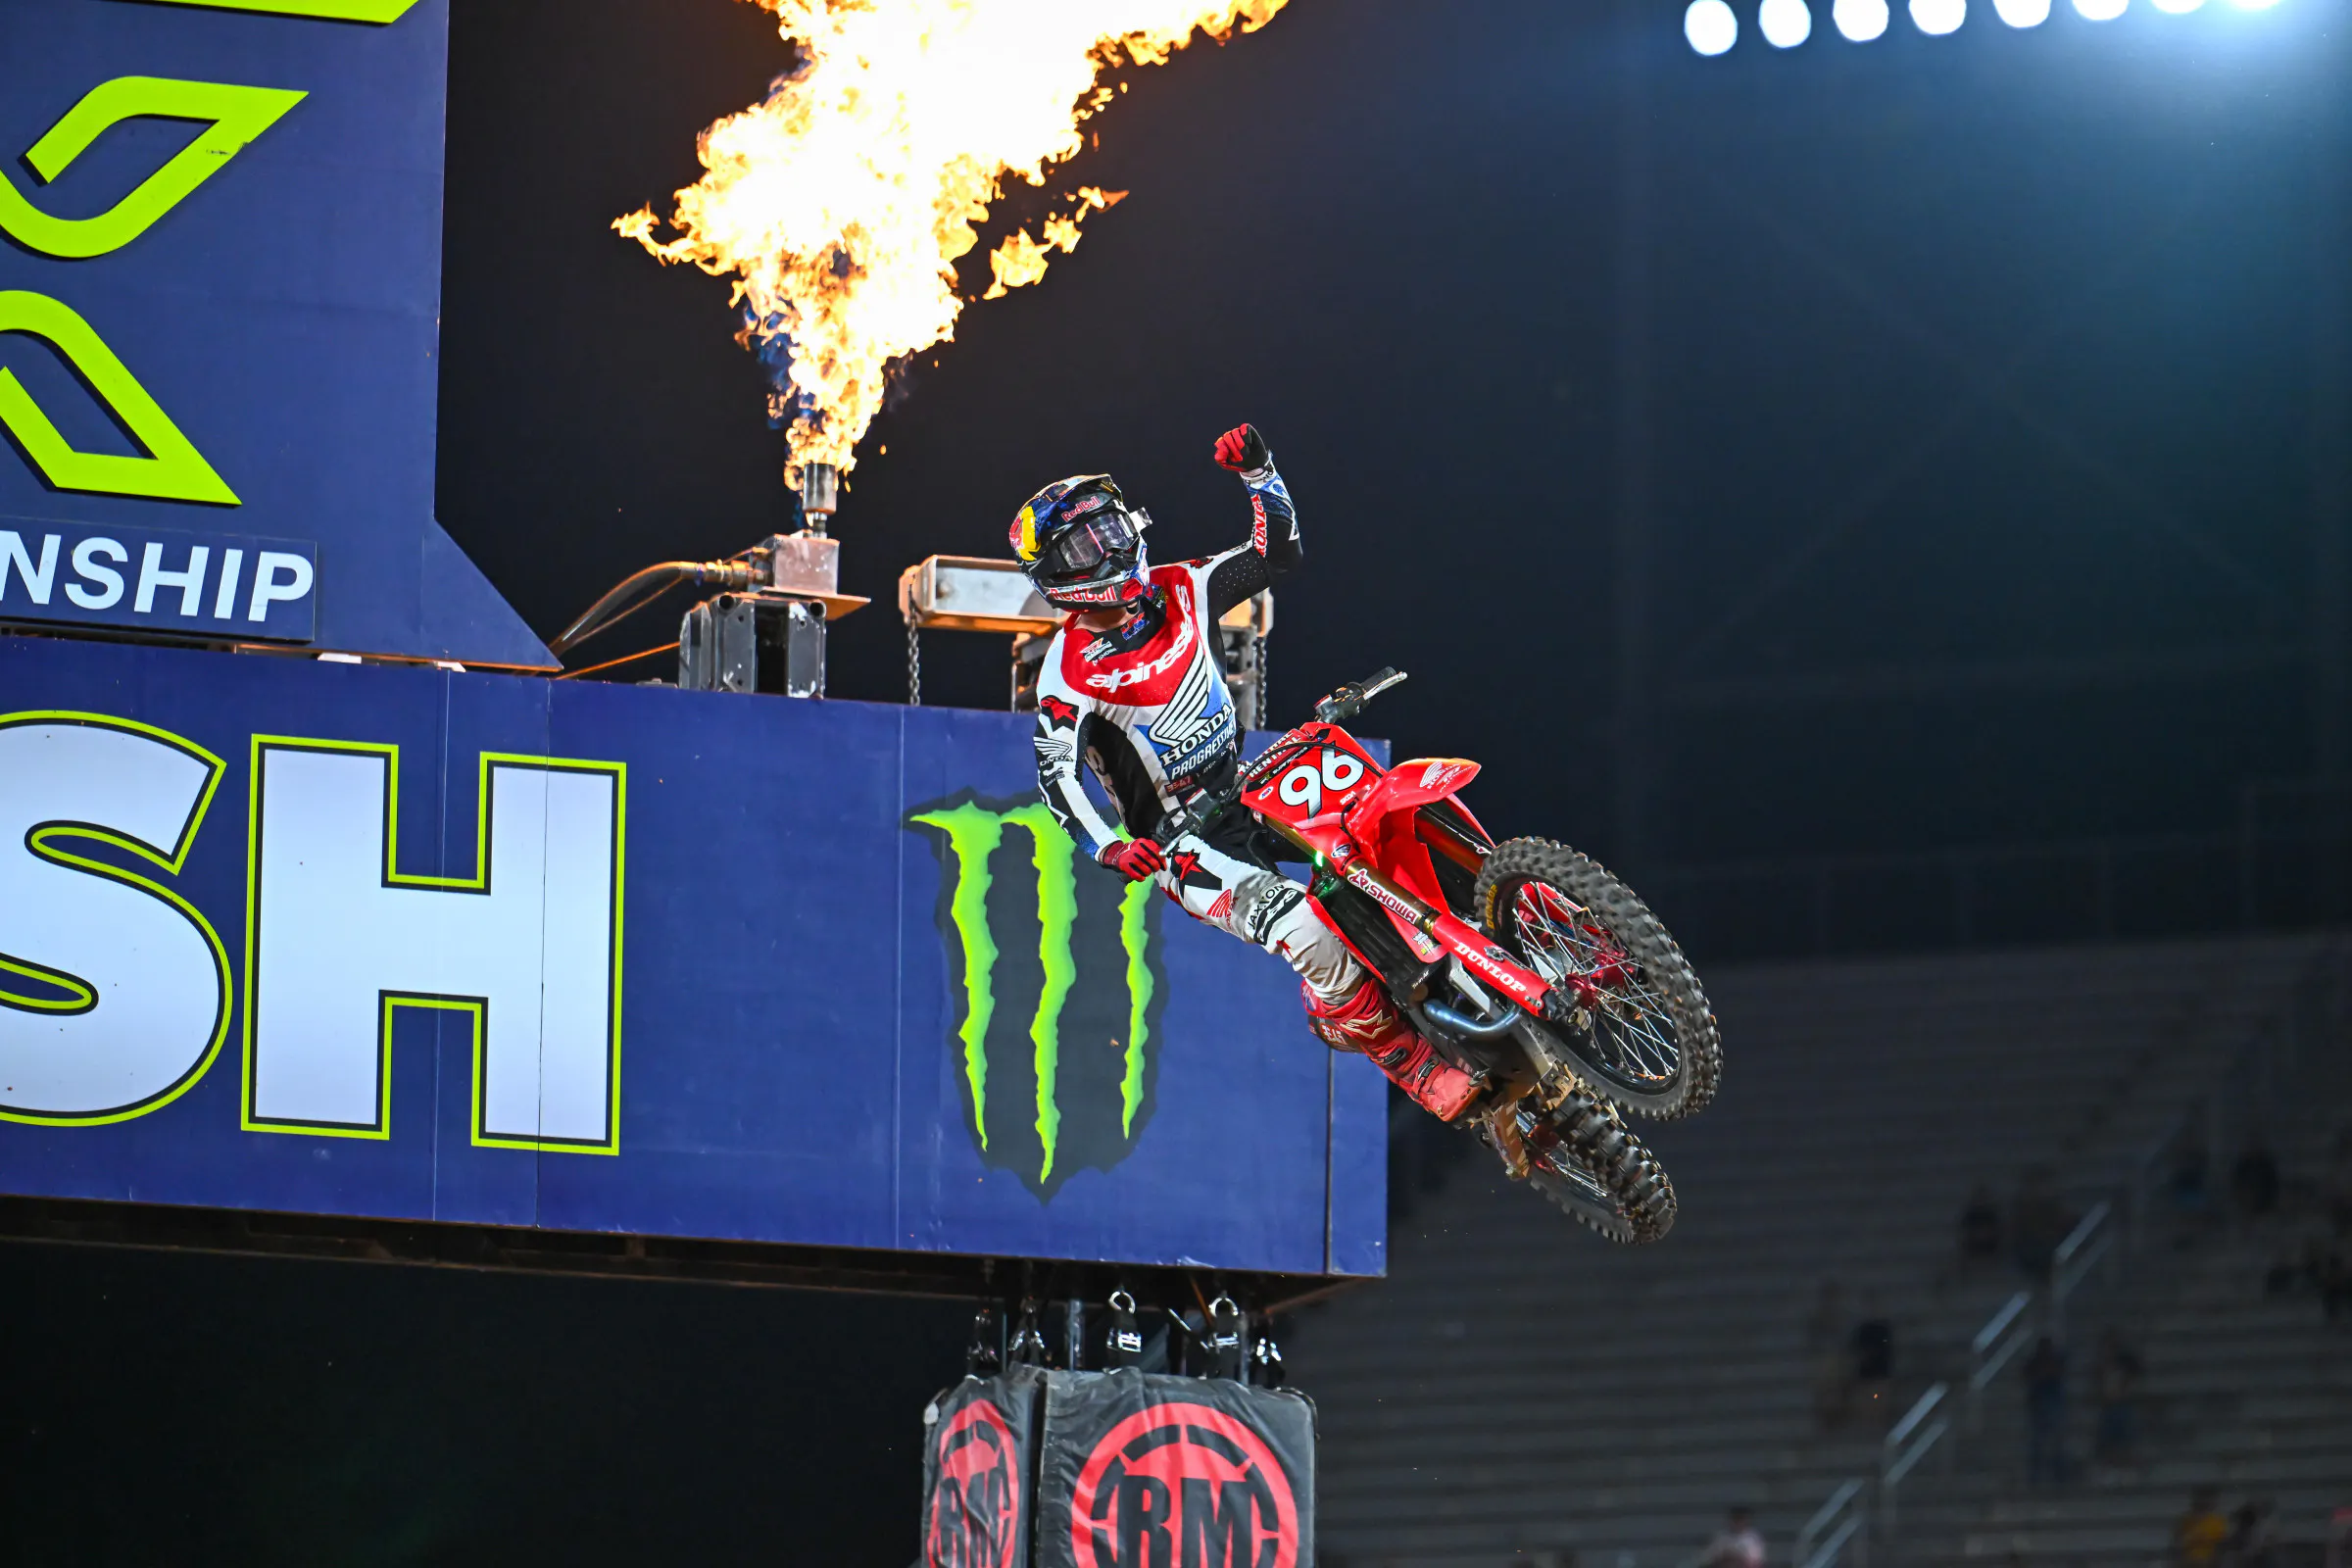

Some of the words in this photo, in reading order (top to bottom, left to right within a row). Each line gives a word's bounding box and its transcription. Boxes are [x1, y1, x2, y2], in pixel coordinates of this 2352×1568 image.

[1159, 703, 1233, 767] HONDA
[1278, 741, 1365, 820] 96
[0, 710, 627, 1156] SH
[1366, 883, 1422, 924] SHOWA
[1454, 942, 1527, 992] DUNLOP
